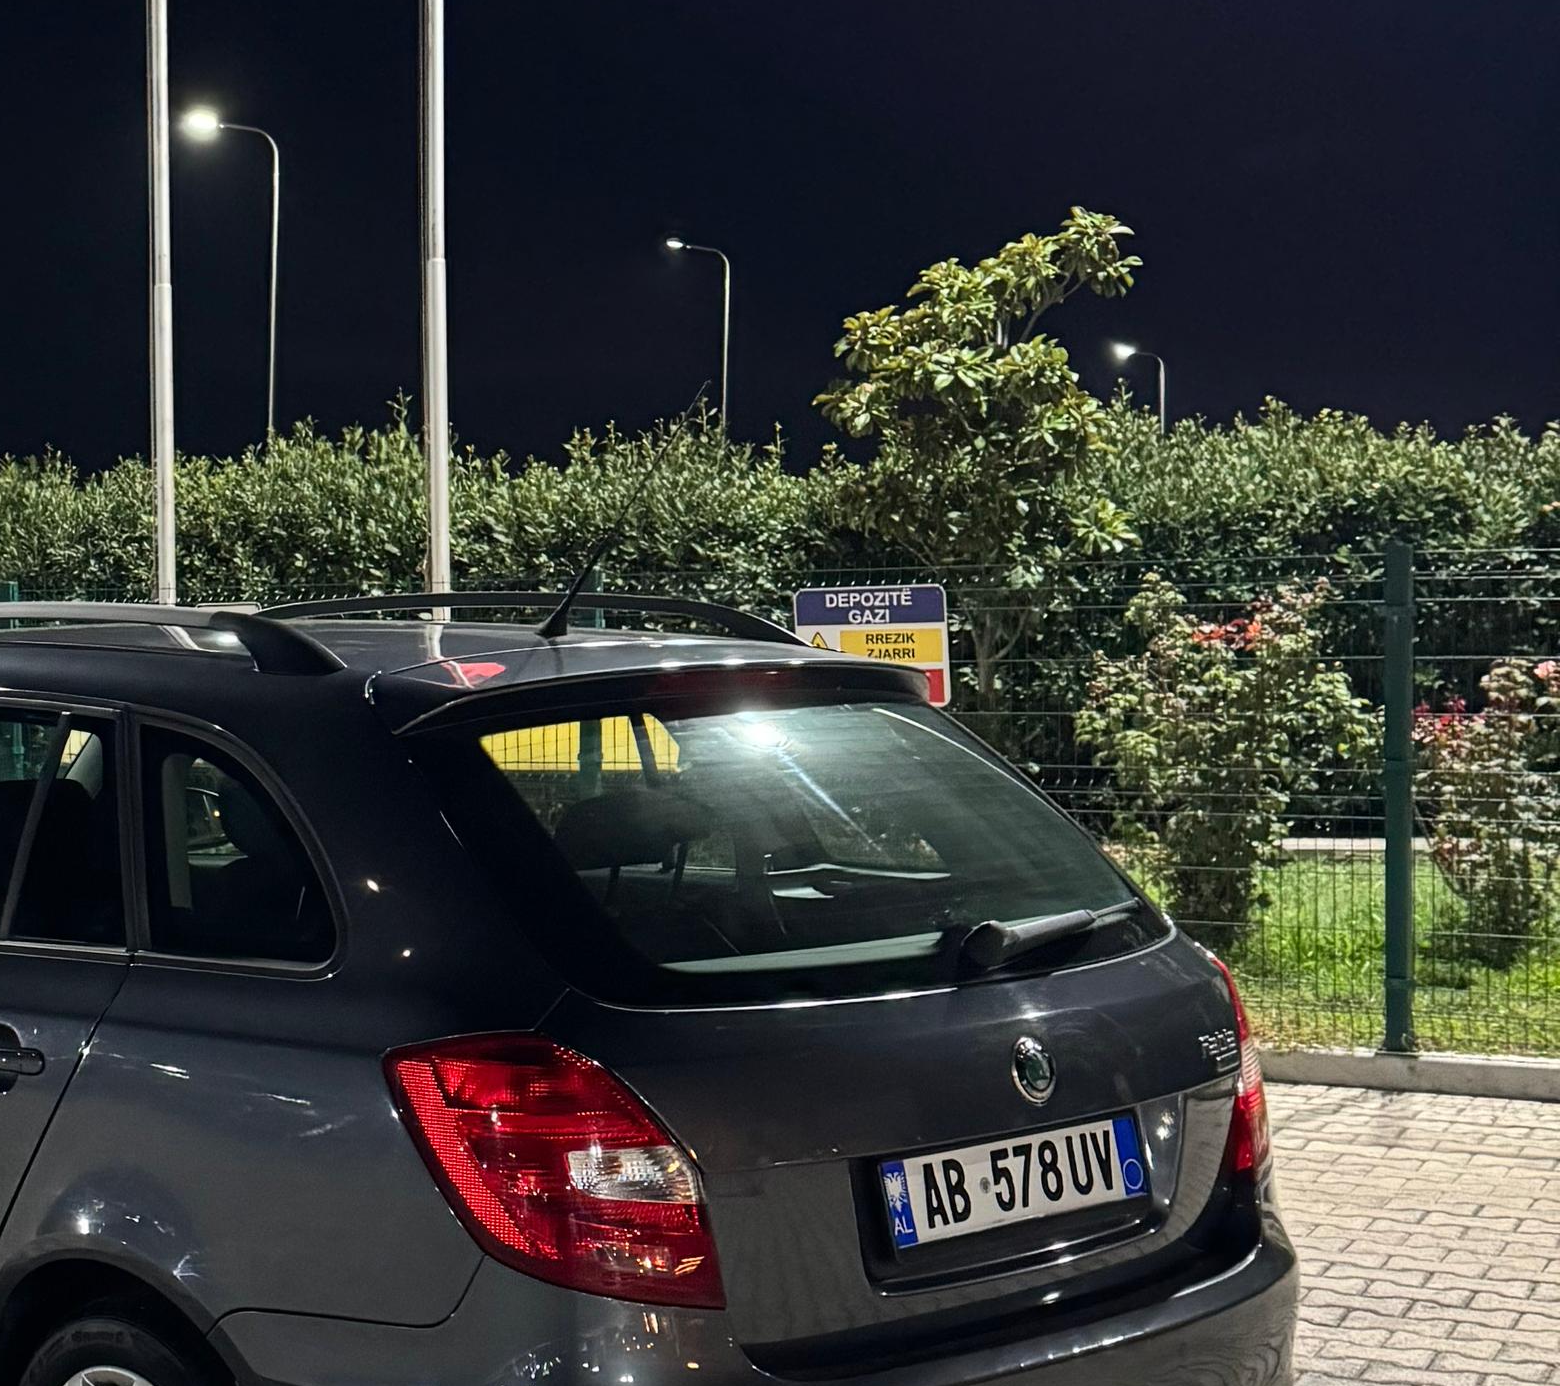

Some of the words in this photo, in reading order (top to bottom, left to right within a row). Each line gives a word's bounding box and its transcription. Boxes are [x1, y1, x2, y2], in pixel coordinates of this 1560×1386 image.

[825, 587, 913, 608] DEPOZITË
[848, 608, 890, 625] GAZI
[865, 632, 916, 645] RREZIK
[921, 1158, 972, 1230] AB
[894, 1216, 914, 1237] AL
